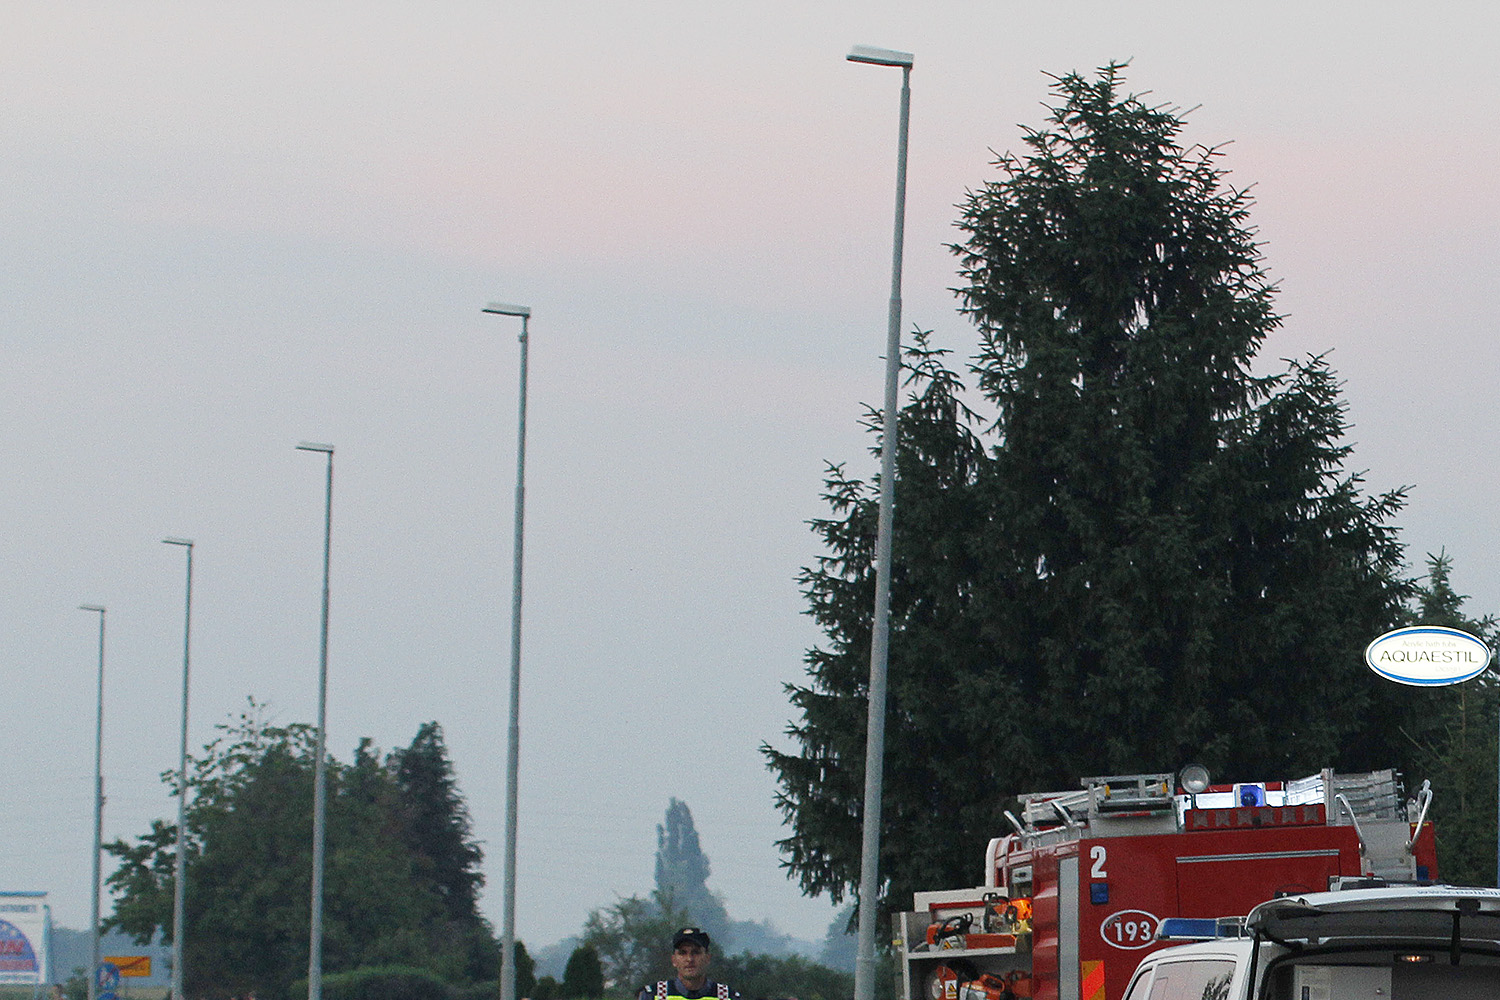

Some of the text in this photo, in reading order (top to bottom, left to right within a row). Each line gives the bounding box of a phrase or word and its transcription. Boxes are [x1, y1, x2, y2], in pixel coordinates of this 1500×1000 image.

[1380, 650, 1479, 663] AQUAESTIL
[1090, 845, 1107, 878] 2
[1114, 921, 1152, 942] 193
